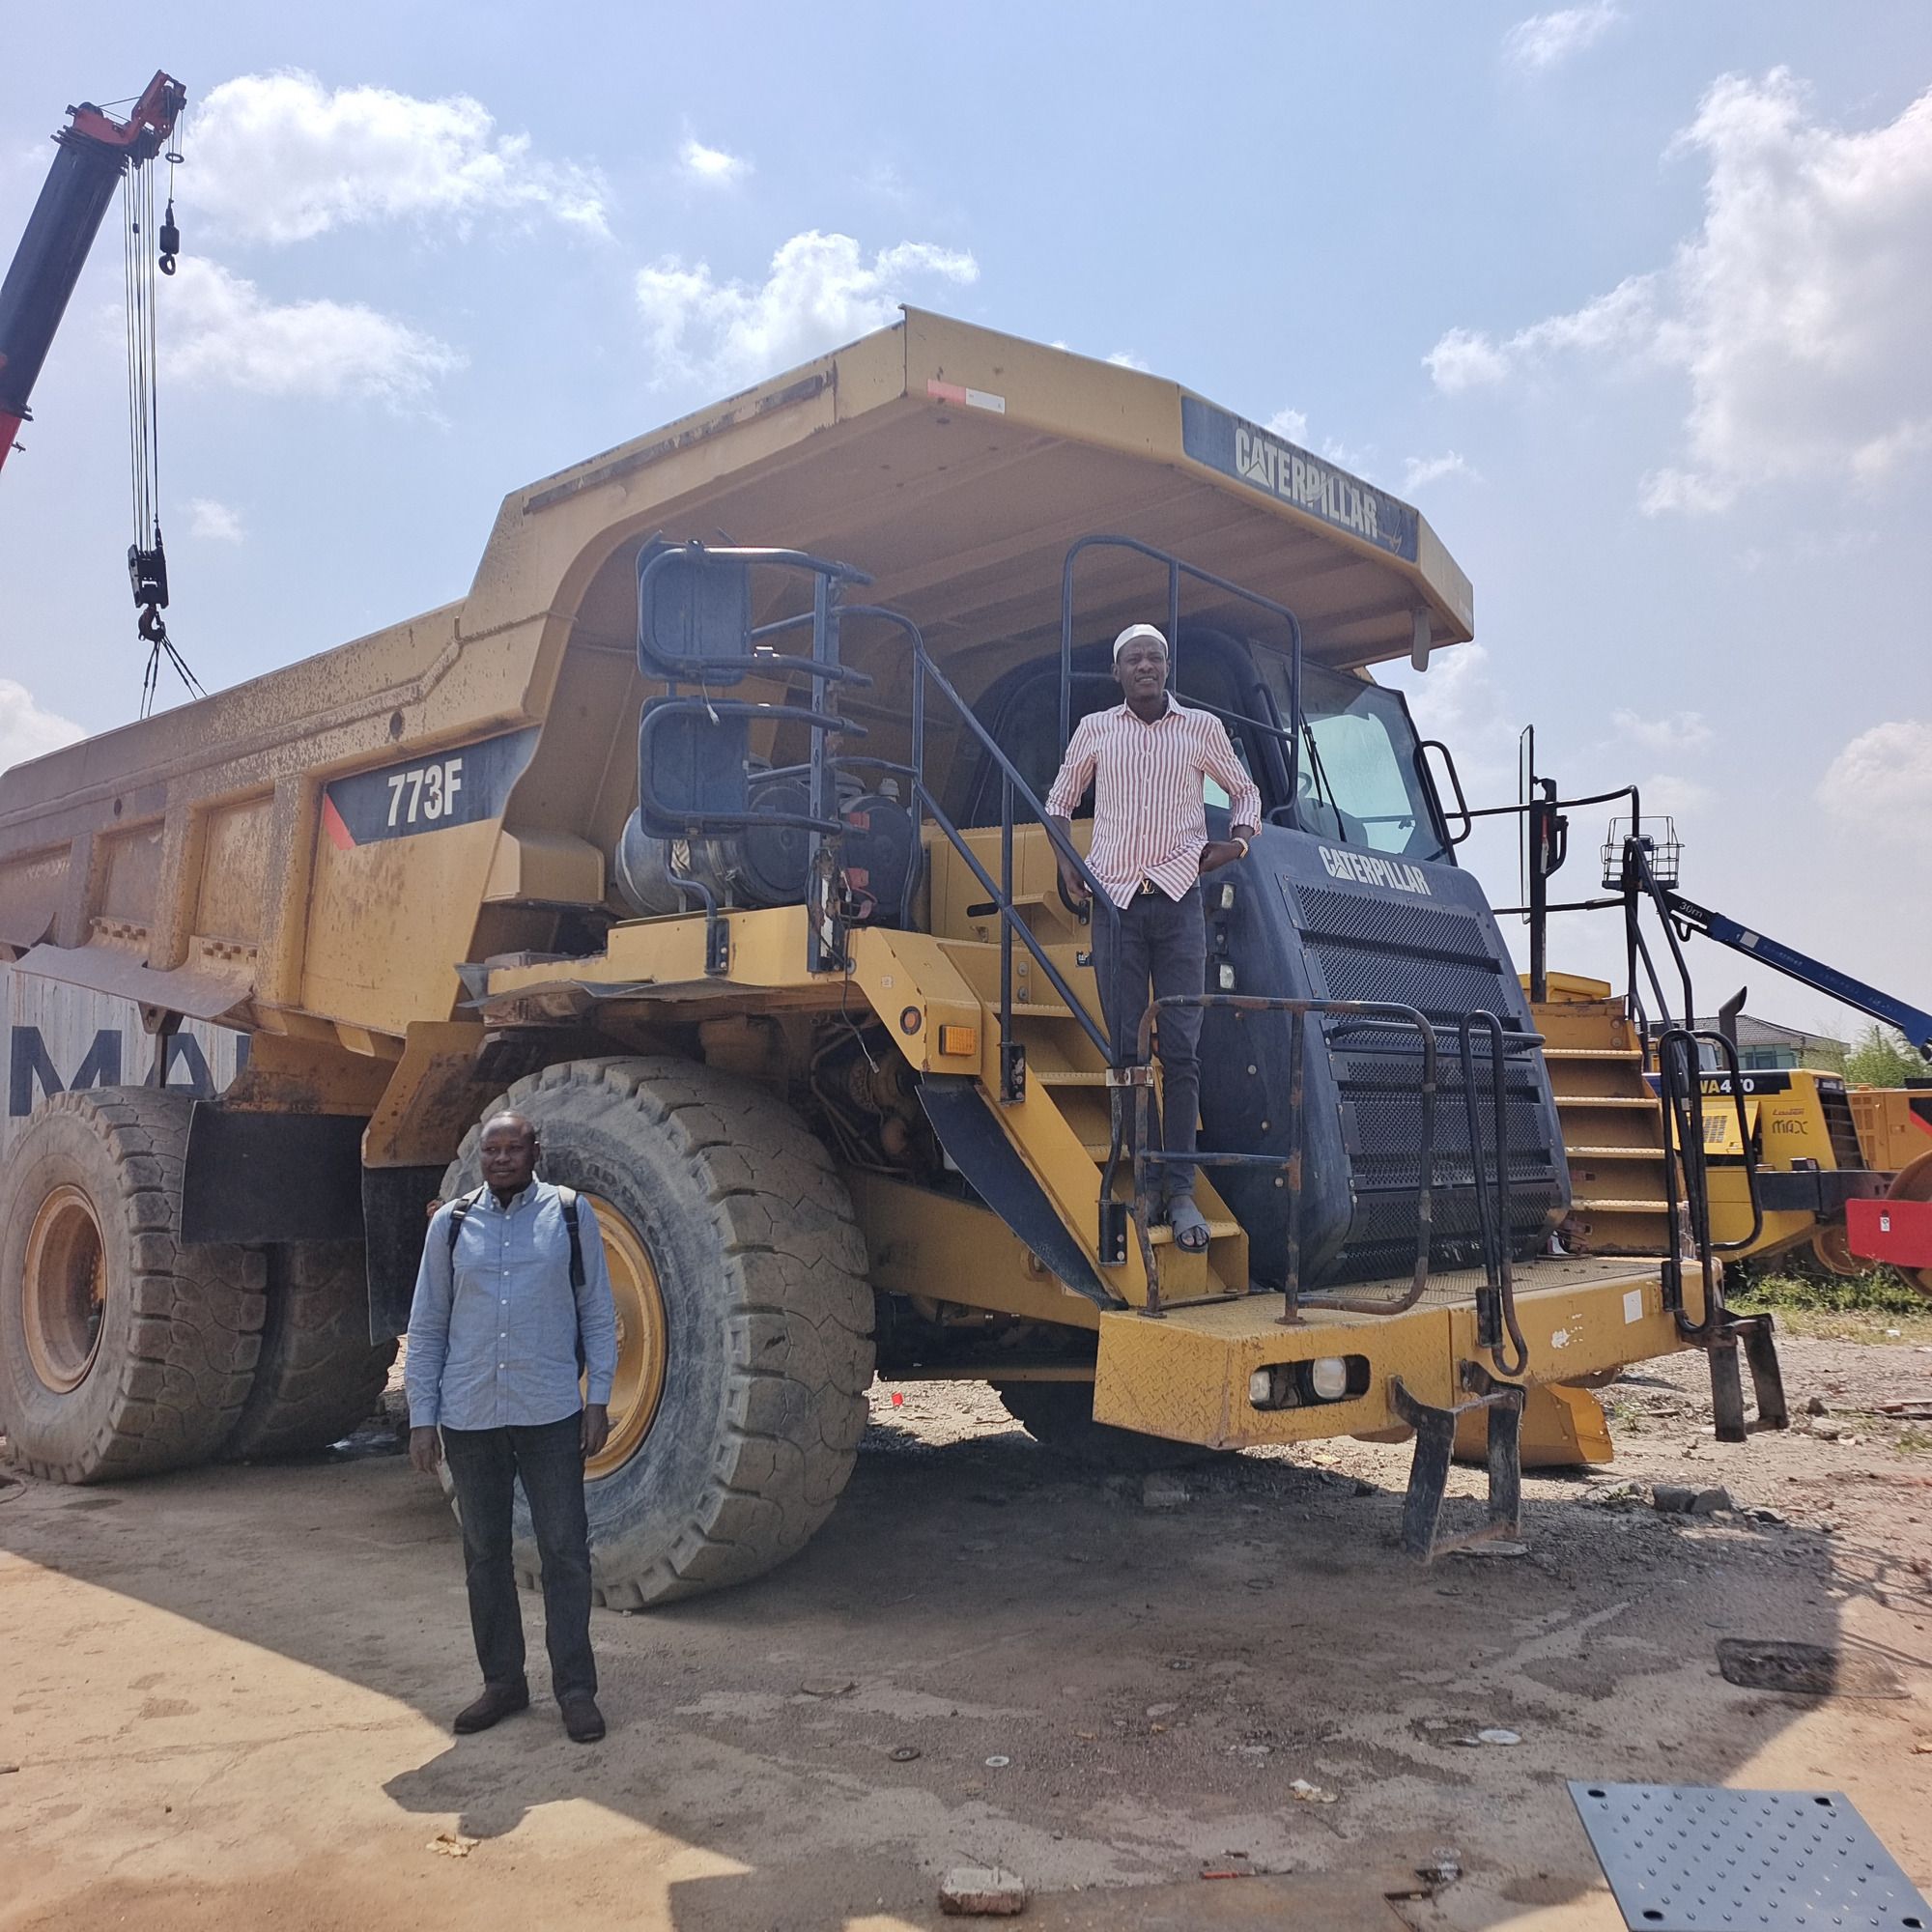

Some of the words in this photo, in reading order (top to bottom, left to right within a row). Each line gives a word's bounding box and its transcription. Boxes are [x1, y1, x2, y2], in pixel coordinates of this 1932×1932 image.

[1236, 428, 1378, 539] CATERPILLAR
[387, 757, 463, 827] 773F
[1318, 845, 1432, 896] CATERPILLAR
[1679, 901, 1703, 918] 30m
[10, 1026, 252, 1117] MA
[1699, 1078, 1755, 1094] WA40
[1772, 1120, 1809, 1135] MAX
